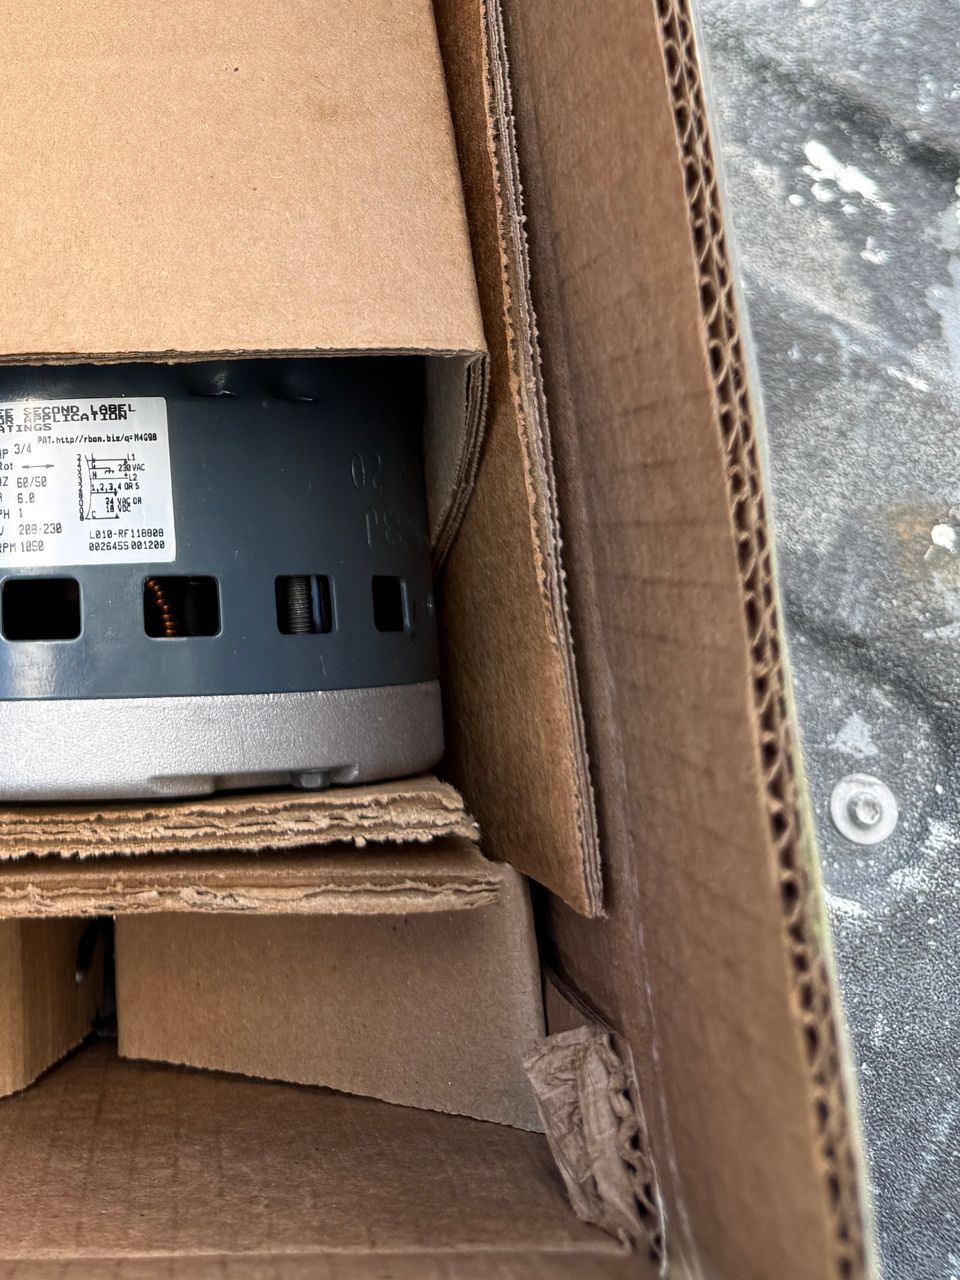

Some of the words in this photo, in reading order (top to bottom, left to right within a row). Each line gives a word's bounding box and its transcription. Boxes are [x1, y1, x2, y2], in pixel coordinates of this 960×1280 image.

[24, 405, 80, 416] SECOND
[90, 404, 136, 414] LABEL
[24, 412, 128, 424] APPLICATION
[14, 443, 32, 455] 3/4
[132, 464, 145, 472] VAC
[16, 476, 47, 489] 60/50
[17, 493, 35, 504] 6.0
[21, 540, 44, 552] 1050
